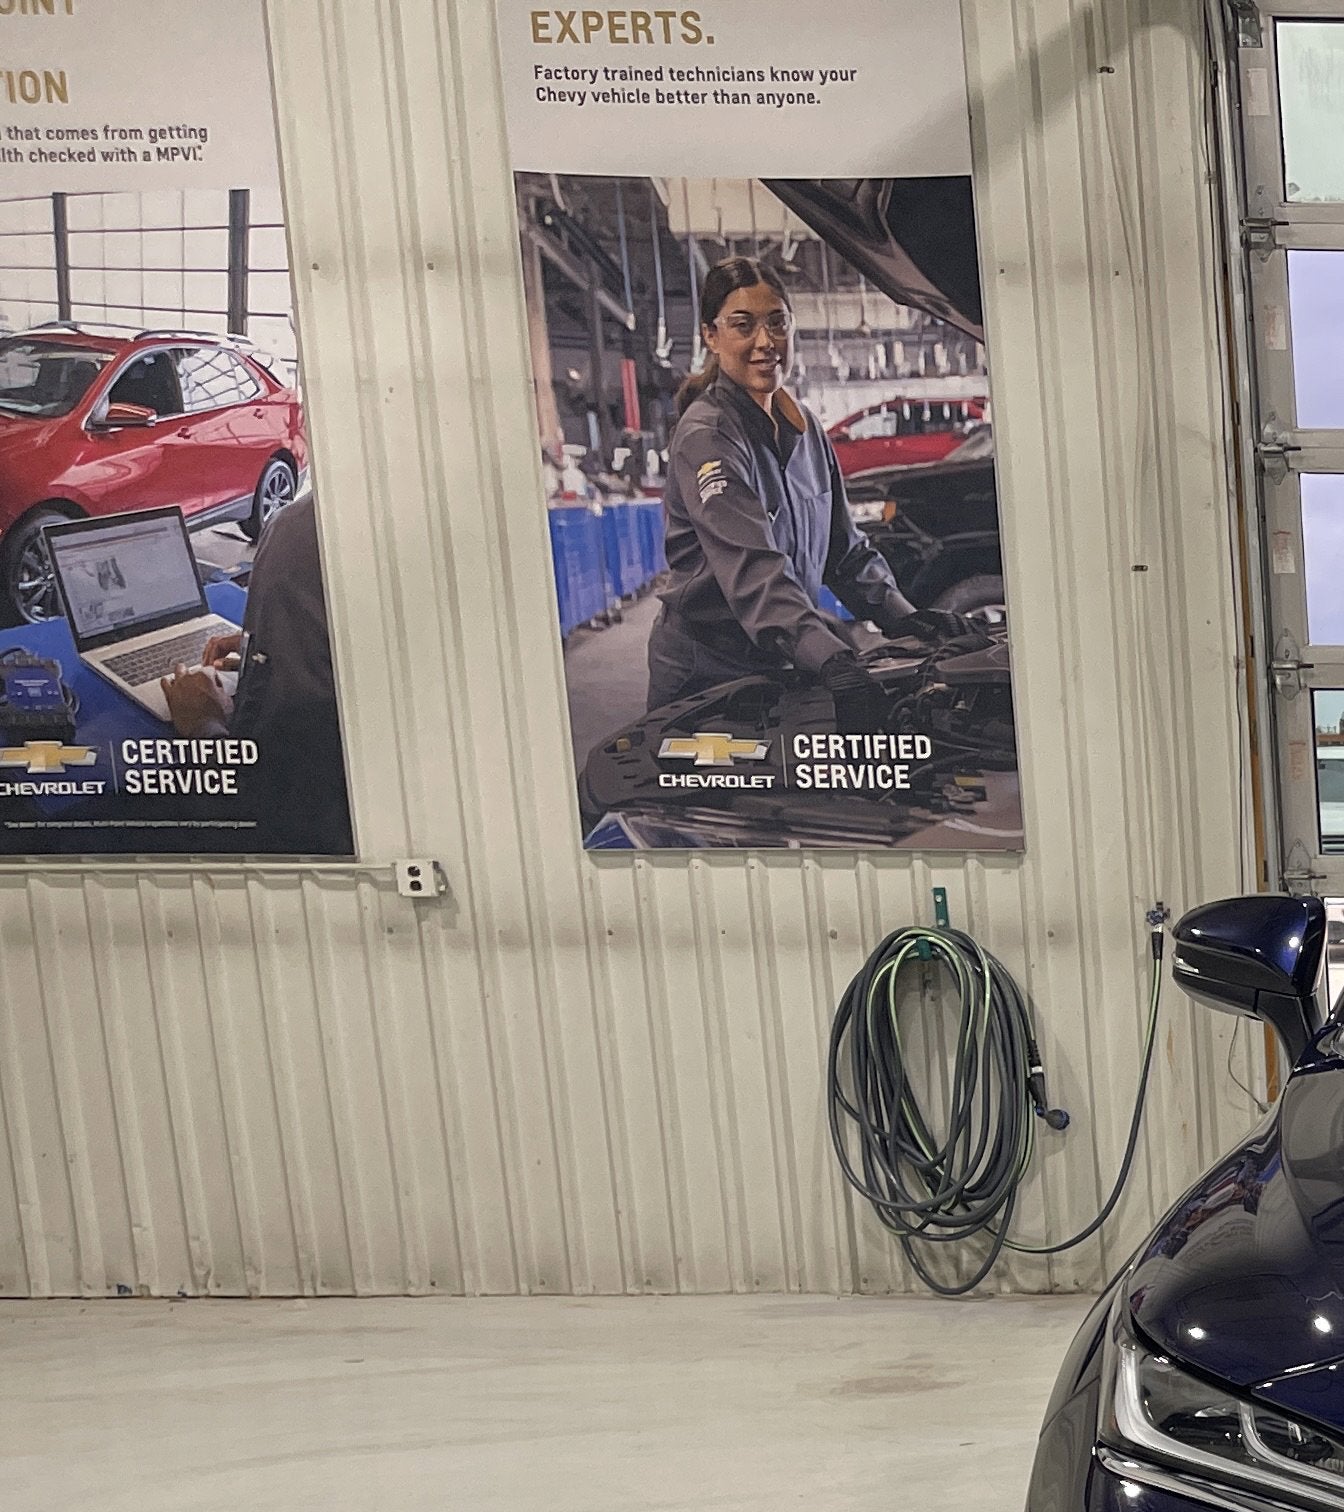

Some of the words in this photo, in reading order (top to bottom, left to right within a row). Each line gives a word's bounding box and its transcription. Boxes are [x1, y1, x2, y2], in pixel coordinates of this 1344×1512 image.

[530, 10, 715, 45] EXPERTS.
[0, 70, 69, 104] ION
[533, 64, 599, 85] Factory
[603, 65, 664, 82] trained
[668, 65, 765, 82] technicians
[770, 65, 815, 82] know
[818, 69, 857, 86] your
[535, 86, 587, 106] Chevy
[591, 87, 650, 104] vehicle
[655, 88, 708, 104] better
[712, 89, 751, 104] than
[756, 92, 821, 108] anyone.
[6, 125, 41, 141] that
[45, 128, 99, 141] comes
[103, 124, 144, 140] from
[148, 124, 208, 144] getting
[28, 146, 97, 163] checked
[100, 147, 138, 162] with
[142, 150, 152, 162] a
[121, 739, 259, 765] CERTIFIED
[793, 734, 933, 760] CERTIFIED
[124, 769, 239, 795] SERVICE
[658, 774, 776, 789] CHEVROLET
[795, 764, 911, 789] SERVICE
